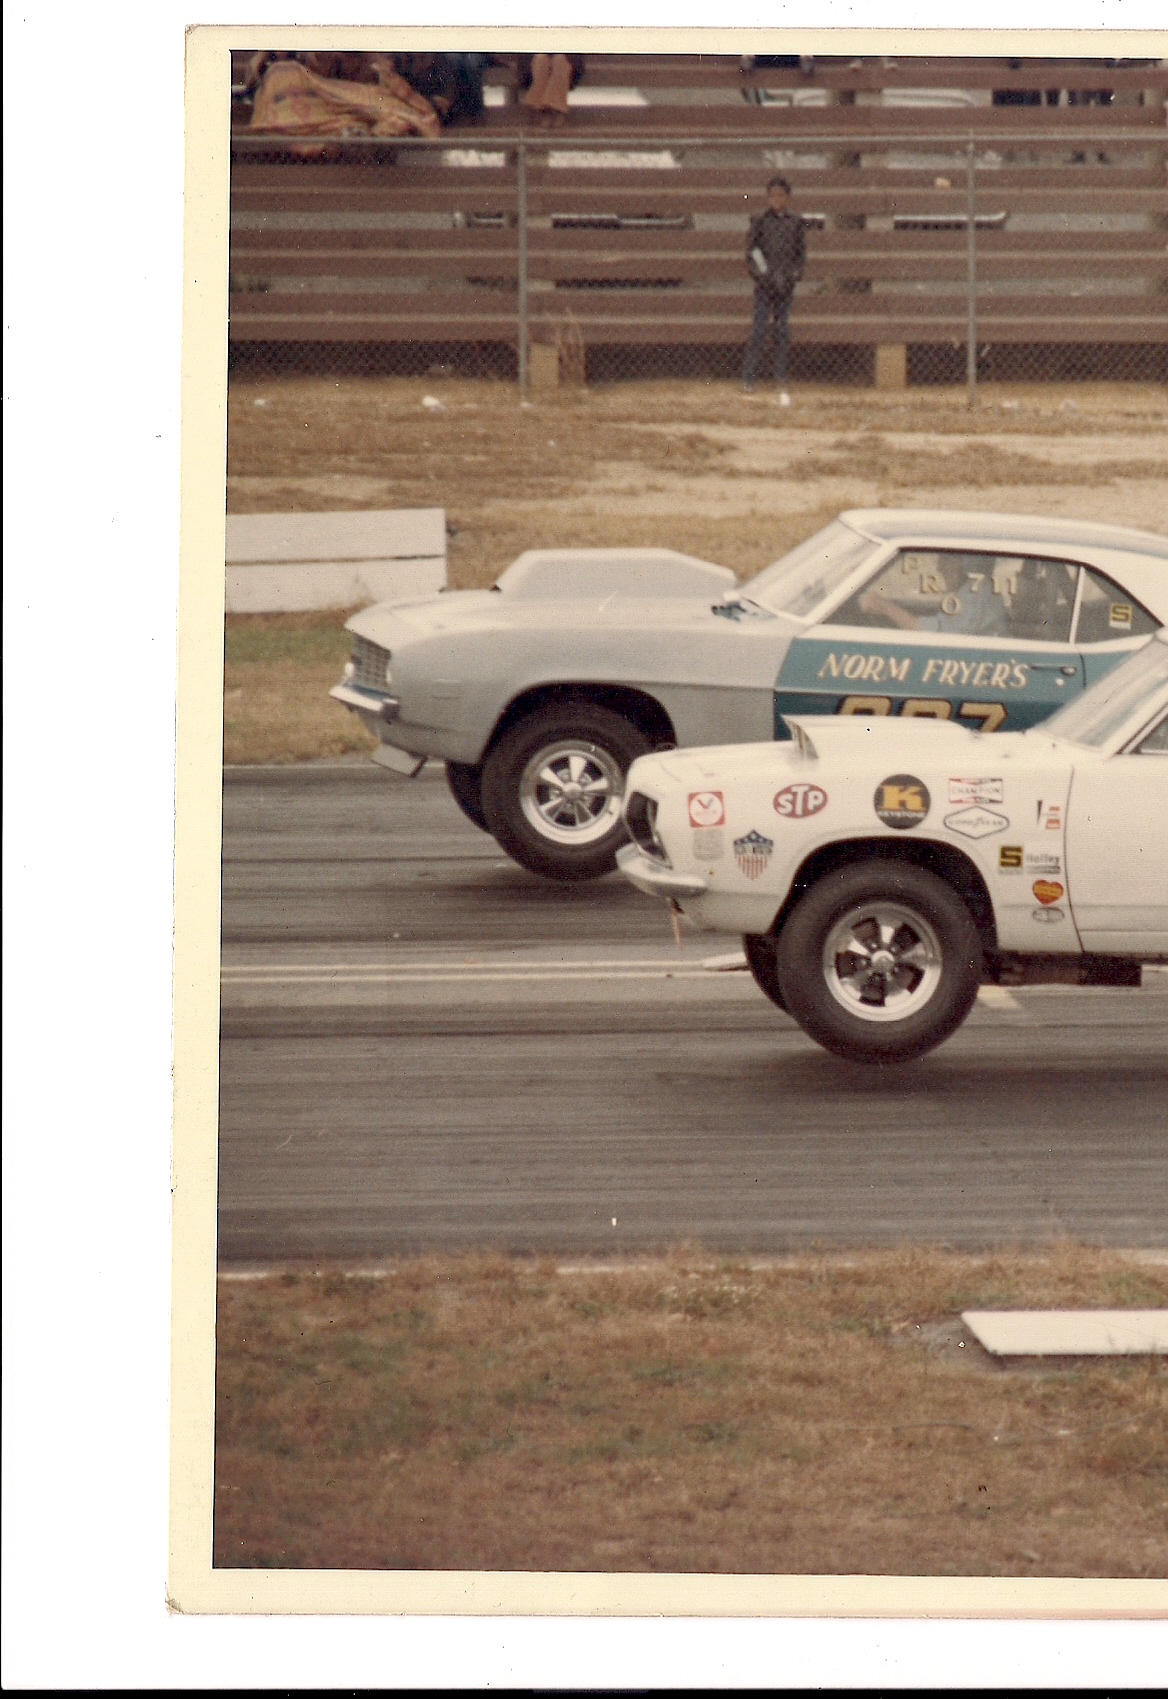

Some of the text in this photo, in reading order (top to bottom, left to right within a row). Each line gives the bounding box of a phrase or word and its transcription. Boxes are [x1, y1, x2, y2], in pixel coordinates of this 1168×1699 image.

[817, 652, 1029, 690] NORM FRYER'S
[777, 785, 824, 816] STP
[881, 785, 925, 811] K
